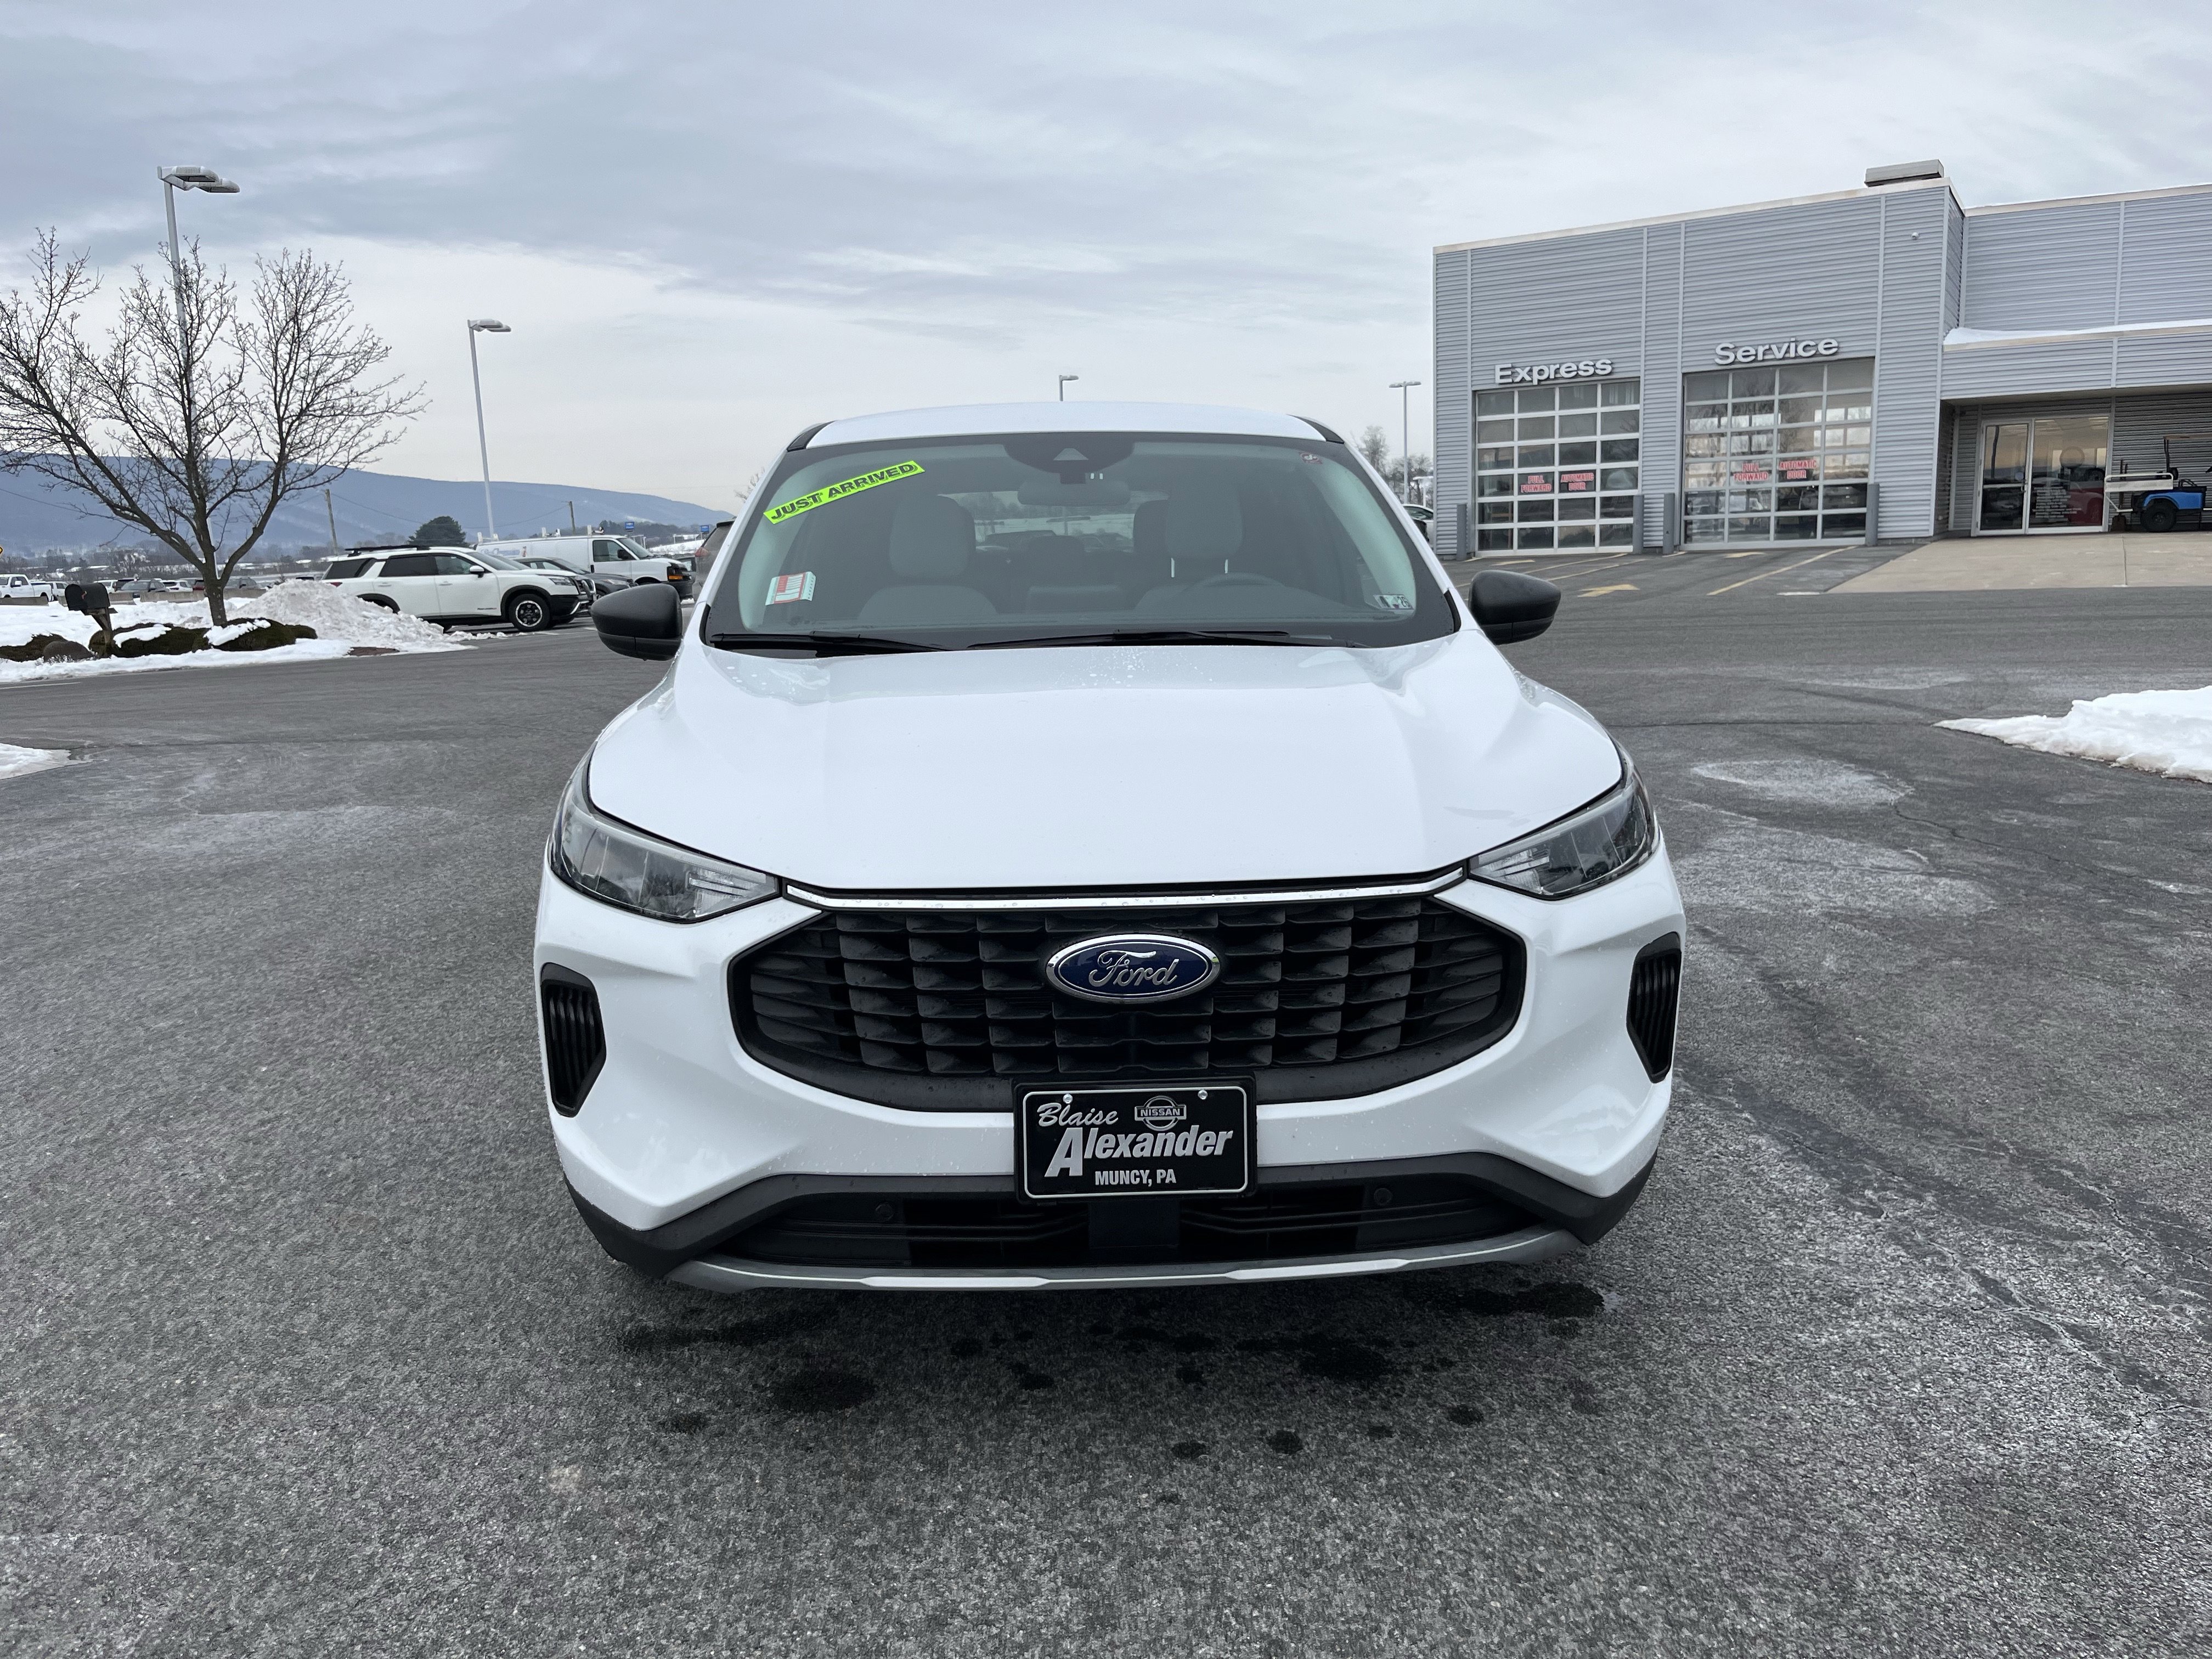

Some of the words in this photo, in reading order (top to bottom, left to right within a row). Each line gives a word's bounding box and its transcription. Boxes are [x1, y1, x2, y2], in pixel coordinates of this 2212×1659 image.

[1714, 338, 1838, 365] Service
[1495, 359, 1612, 385] Express
[1734, 472, 1769, 482] FORWARD
[1779, 459, 1817, 470] AUTOMATIC
[1521, 483, 1552, 493] FORWARD
[1561, 472, 1594, 483] AUTOMATIC
[771, 492, 822, 520] JUST
[828, 464, 918, 499] ARRIVED
[1088, 950, 1180, 987] Ford
[1037, 1102, 1119, 1127] Blaise
[1140, 1108, 1181, 1117] NISSAN
[1044, 1125, 1234, 1177] Alexander
[1095, 1169, 1152, 1187] MUNCY,
[1156, 1169, 1176, 1184] PA
